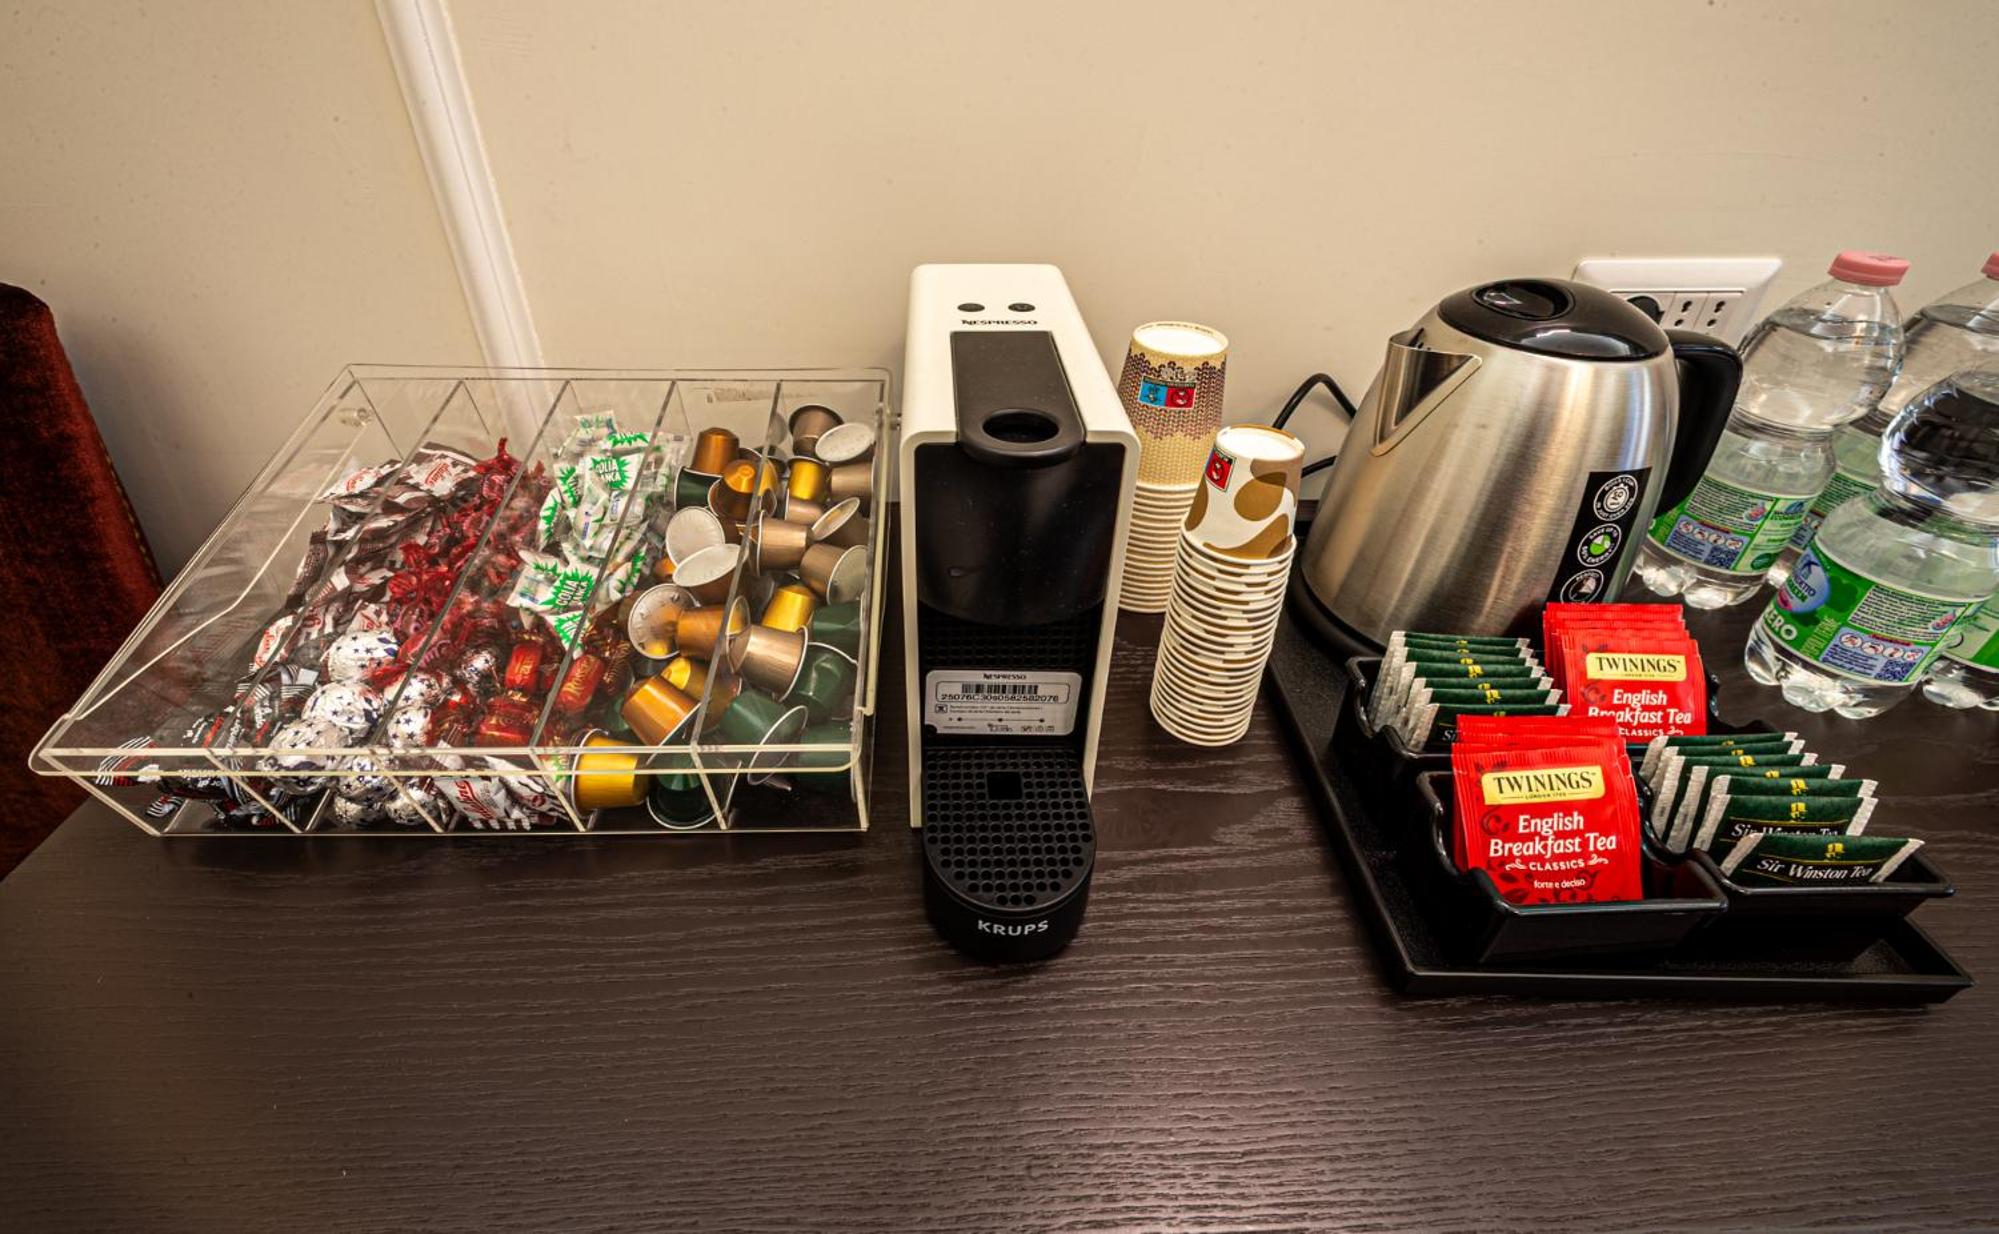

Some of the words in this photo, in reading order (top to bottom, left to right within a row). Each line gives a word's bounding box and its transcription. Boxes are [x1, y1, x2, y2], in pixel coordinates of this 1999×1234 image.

[1595, 656, 1677, 673] TWININGS
[1613, 689, 1668, 708] English
[1666, 708, 1692, 724] Tea
[1619, 728, 1664, 737] CLASSICS
[1493, 771, 1593, 795] TWININGS
[1518, 811, 1584, 836] English
[1489, 835, 1582, 859] Breakfast
[1585, 832, 1617, 851] Tea
[1528, 859, 1585, 871] CLASSICS
[1757, 858, 1785, 873] Sir
[1788, 864, 1848, 880] Winston
[1850, 866, 1874, 878] Tea
[1534, 880, 1554, 889] forte
[1561, 878, 1586, 889] deciso
[977, 919, 1049, 936] KRUPS
